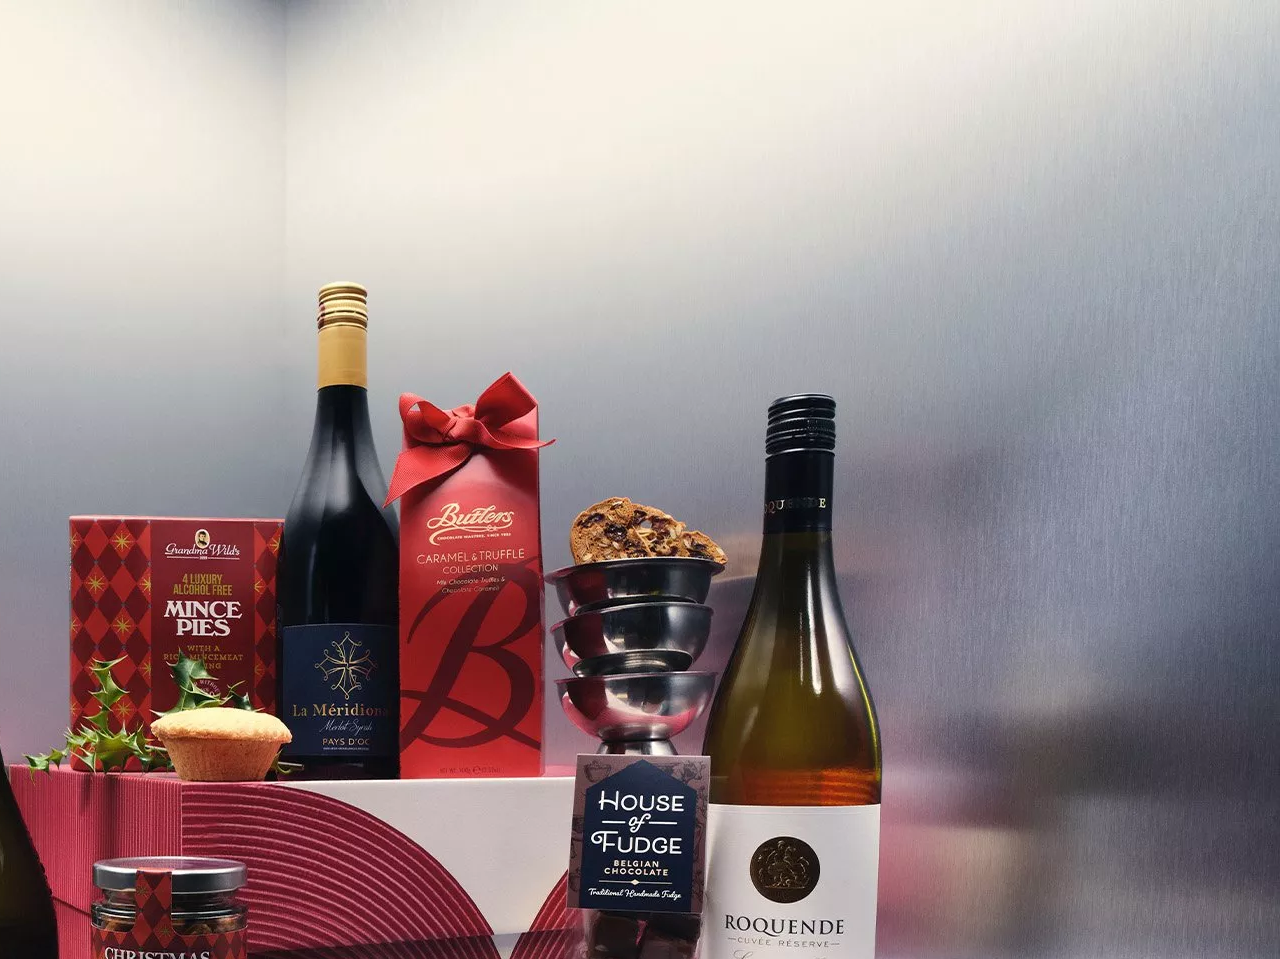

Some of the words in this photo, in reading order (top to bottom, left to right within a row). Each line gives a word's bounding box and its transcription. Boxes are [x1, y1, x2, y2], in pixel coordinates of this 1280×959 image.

[426, 502, 515, 530] Butlers
[164, 542, 208, 555] Grandma
[208, 543, 240, 556] Wild's
[416, 551, 470, 565] CARAMEL
[471, 552, 478, 561] &
[479, 548, 525, 560] TRUFFLE
[442, 563, 499, 575] COLLECTION
[182, 573, 188, 583] 4
[190, 573, 223, 585] LUXURY
[173, 583, 211, 595] ALCOHOL
[212, 584, 233, 596] FREE
[163, 600, 243, 619] MINCE
[176, 618, 231, 637] PIES
[292, 703, 308, 717] La
[322, 737, 345, 746] PAYS
[348, 737, 370, 746] D'OC
[598, 790, 685, 812] HOUSE
[628, 813, 652, 833] of
[590, 830, 682, 854] FUDGE
[613, 859, 659, 868] BELGIAN
[604, 867, 669, 877] CHOCOLATE
[588, 887, 624, 897] Traditional
[625, 888, 660, 898] Handmade
[661, 890, 682, 901] Fudge
[724, 914, 845, 938] ROQUENDE
[737, 936, 771, 946] CUVÉE
[778, 937, 830, 948] RÉSERVE
